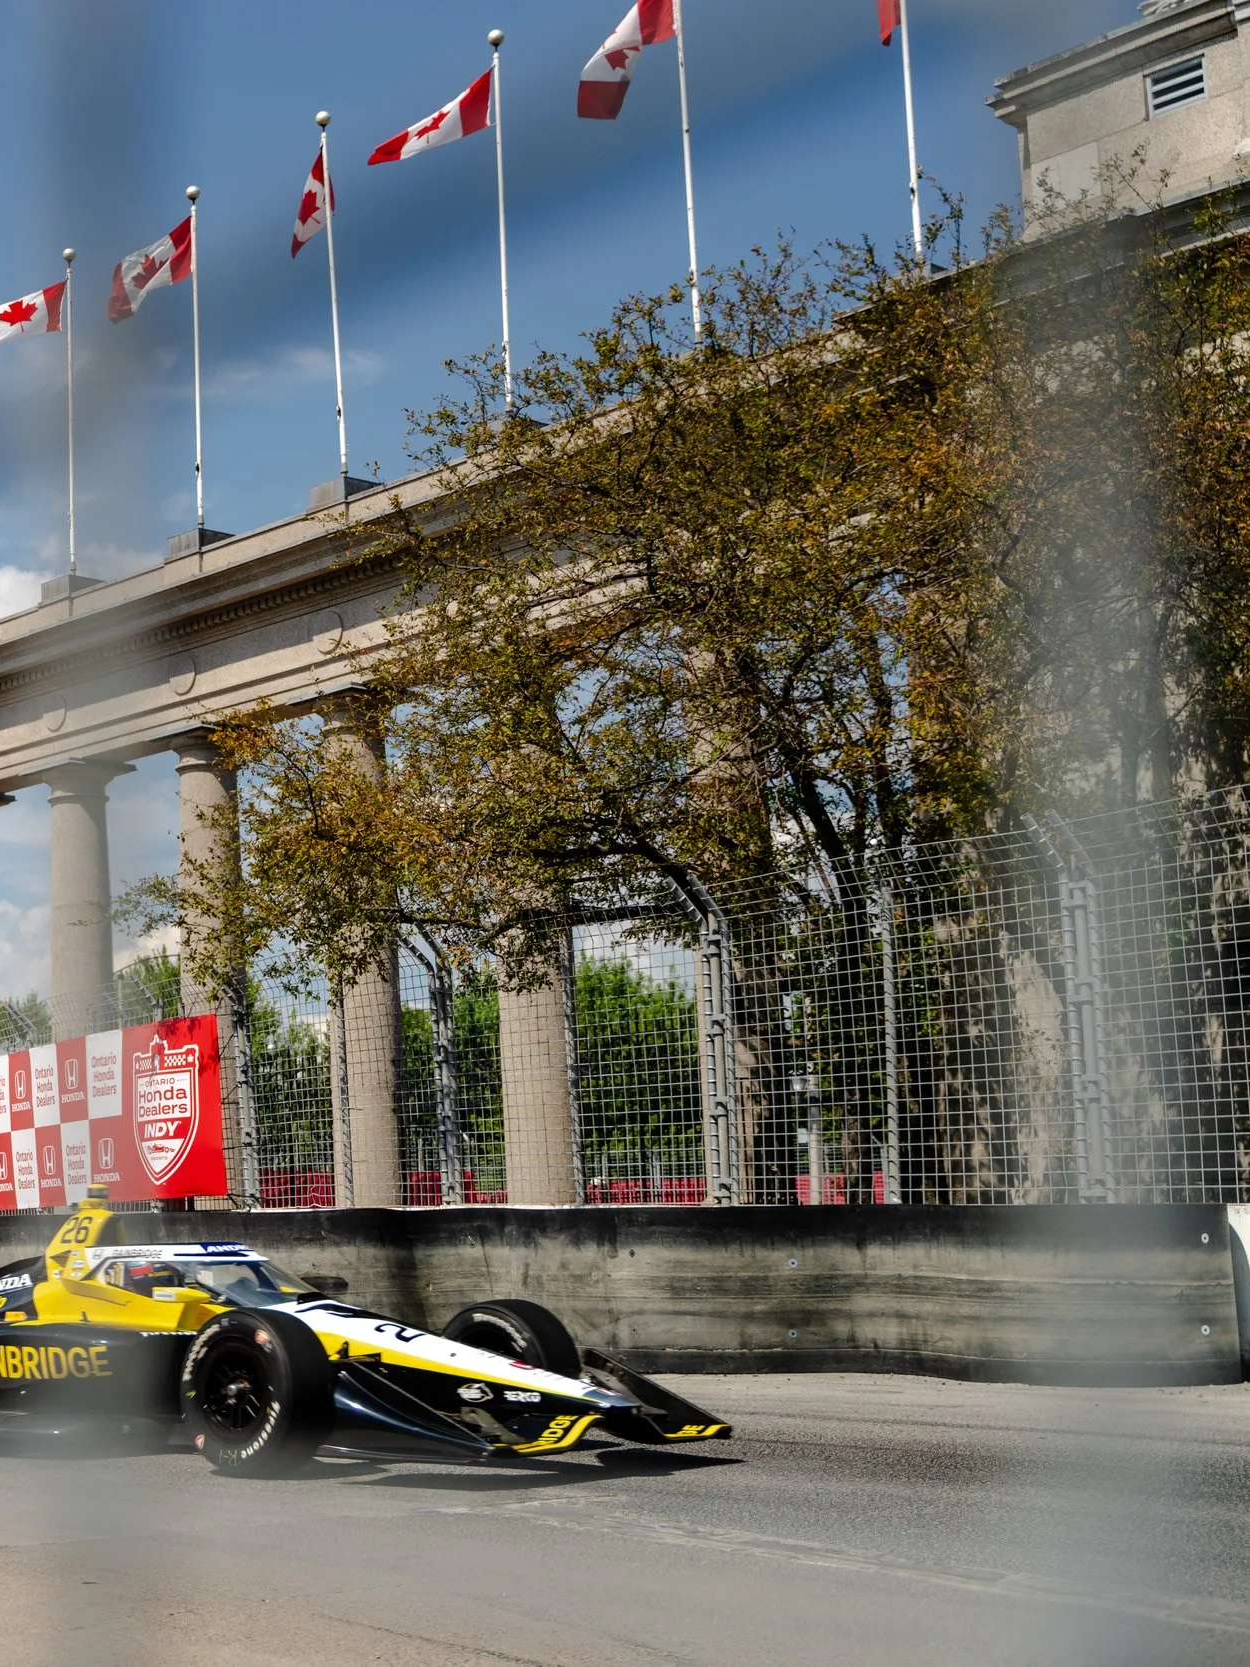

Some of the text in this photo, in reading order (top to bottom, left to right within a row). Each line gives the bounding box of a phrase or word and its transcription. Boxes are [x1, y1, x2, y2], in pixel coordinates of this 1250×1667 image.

[91, 1052, 117, 1068] Ontario
[35, 1064, 54, 1078] Ontario
[93, 1068, 115, 1082] Honda
[36, 1079, 54, 1093] Honda
[92, 1083, 118, 1098] Dealers
[36, 1093, 56, 1108] Dealers
[61, 1091, 86, 1104] HONDA
[138, 1086, 188, 1104] Honda
[11, 1101, 31, 1112] HONDA
[138, 1102, 189, 1119] Dealers
[144, 1121, 179, 1139] INDY
[15, 1149, 34, 1162] Ontario
[65, 1142, 87, 1157] Ontario
[17, 1164, 34, 1176] Honda
[67, 1157, 86, 1171] Honda
[17, 1176, 36, 1190] Dealers
[40, 1177, 63, 1188] HONDA
[67, 1171, 88, 1186] Dealers
[93, 1172, 121, 1183] HONDA
[61, 1216, 93, 1244] 26
[112, 1249, 163, 1259] GAINBRIDGE
